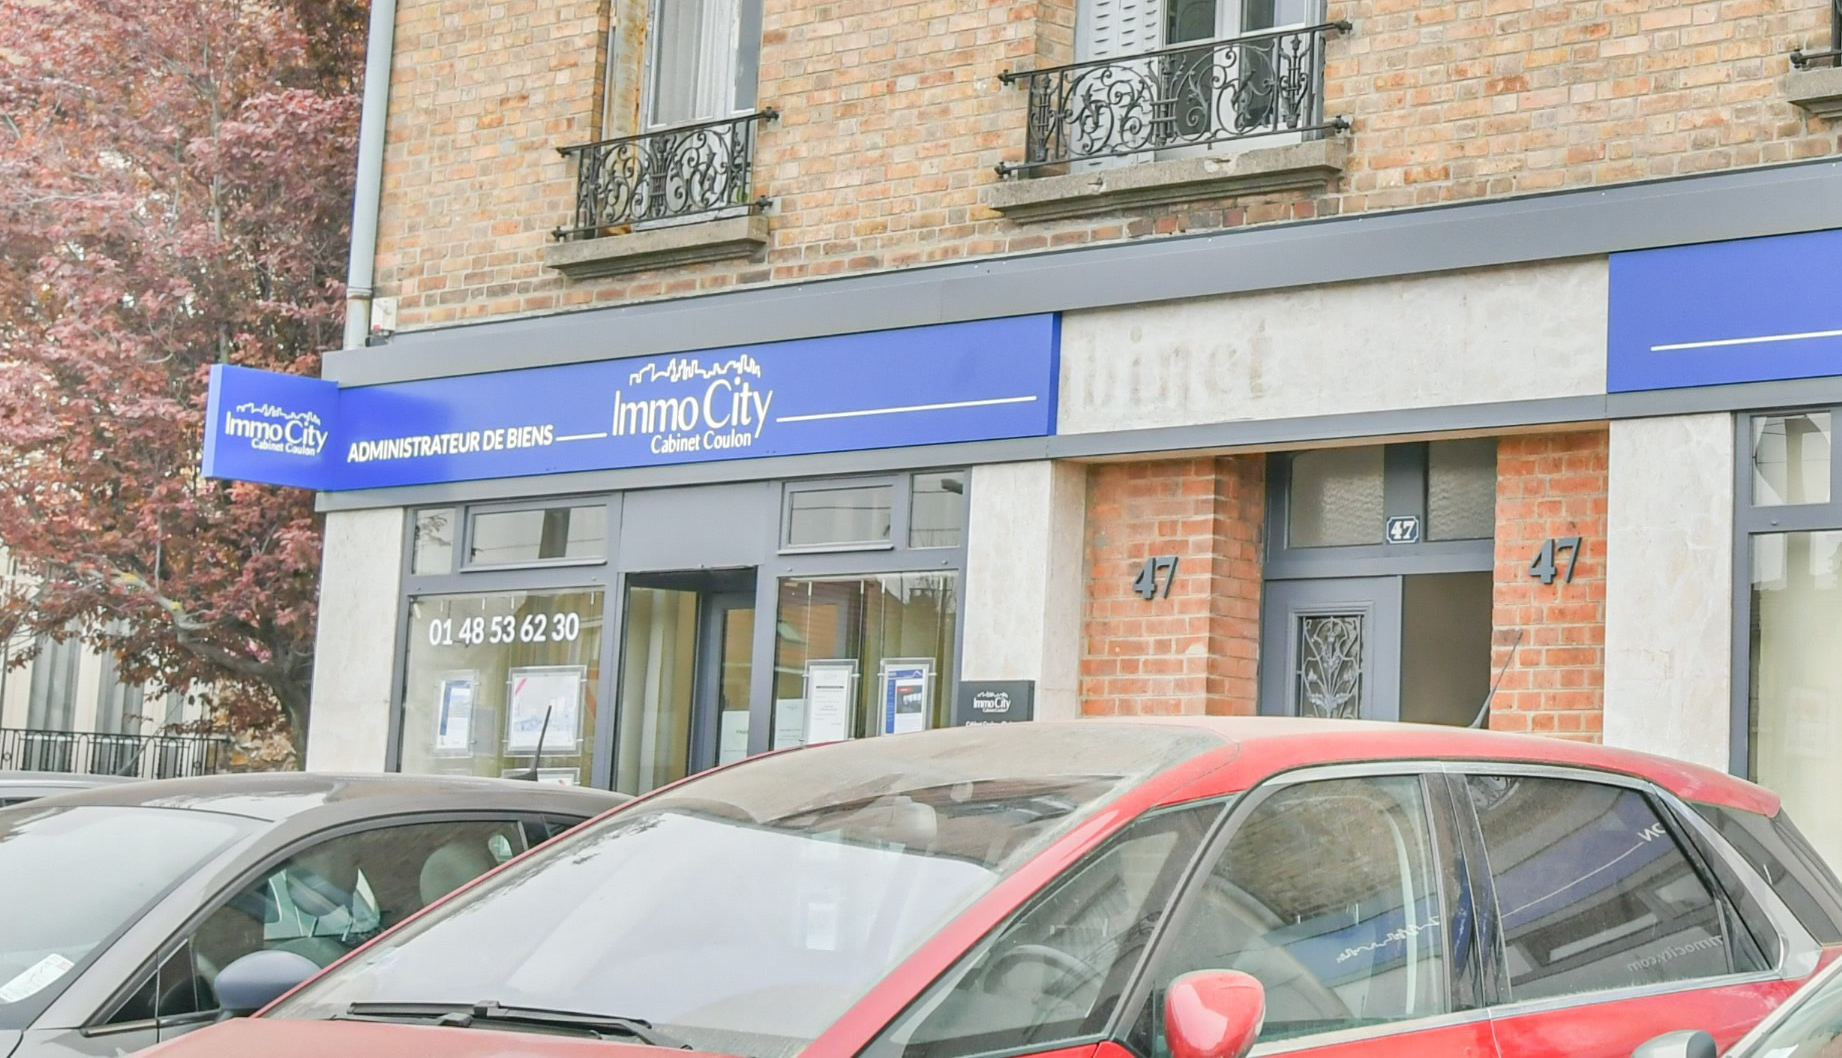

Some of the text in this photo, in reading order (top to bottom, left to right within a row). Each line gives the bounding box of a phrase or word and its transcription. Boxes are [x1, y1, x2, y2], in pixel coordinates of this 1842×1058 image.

[251, 438, 316, 457] Cabinet Coulon
[347, 424, 554, 463] ADMINISTRATEUR DE BIENS
[650, 428, 752, 454] Cabinet Coulon
[1391, 521, 1416, 540] 47
[1528, 537, 1582, 584] 47
[1132, 556, 1179, 600] 47
[429, 612, 580, 646] 01 48 53 62 30
